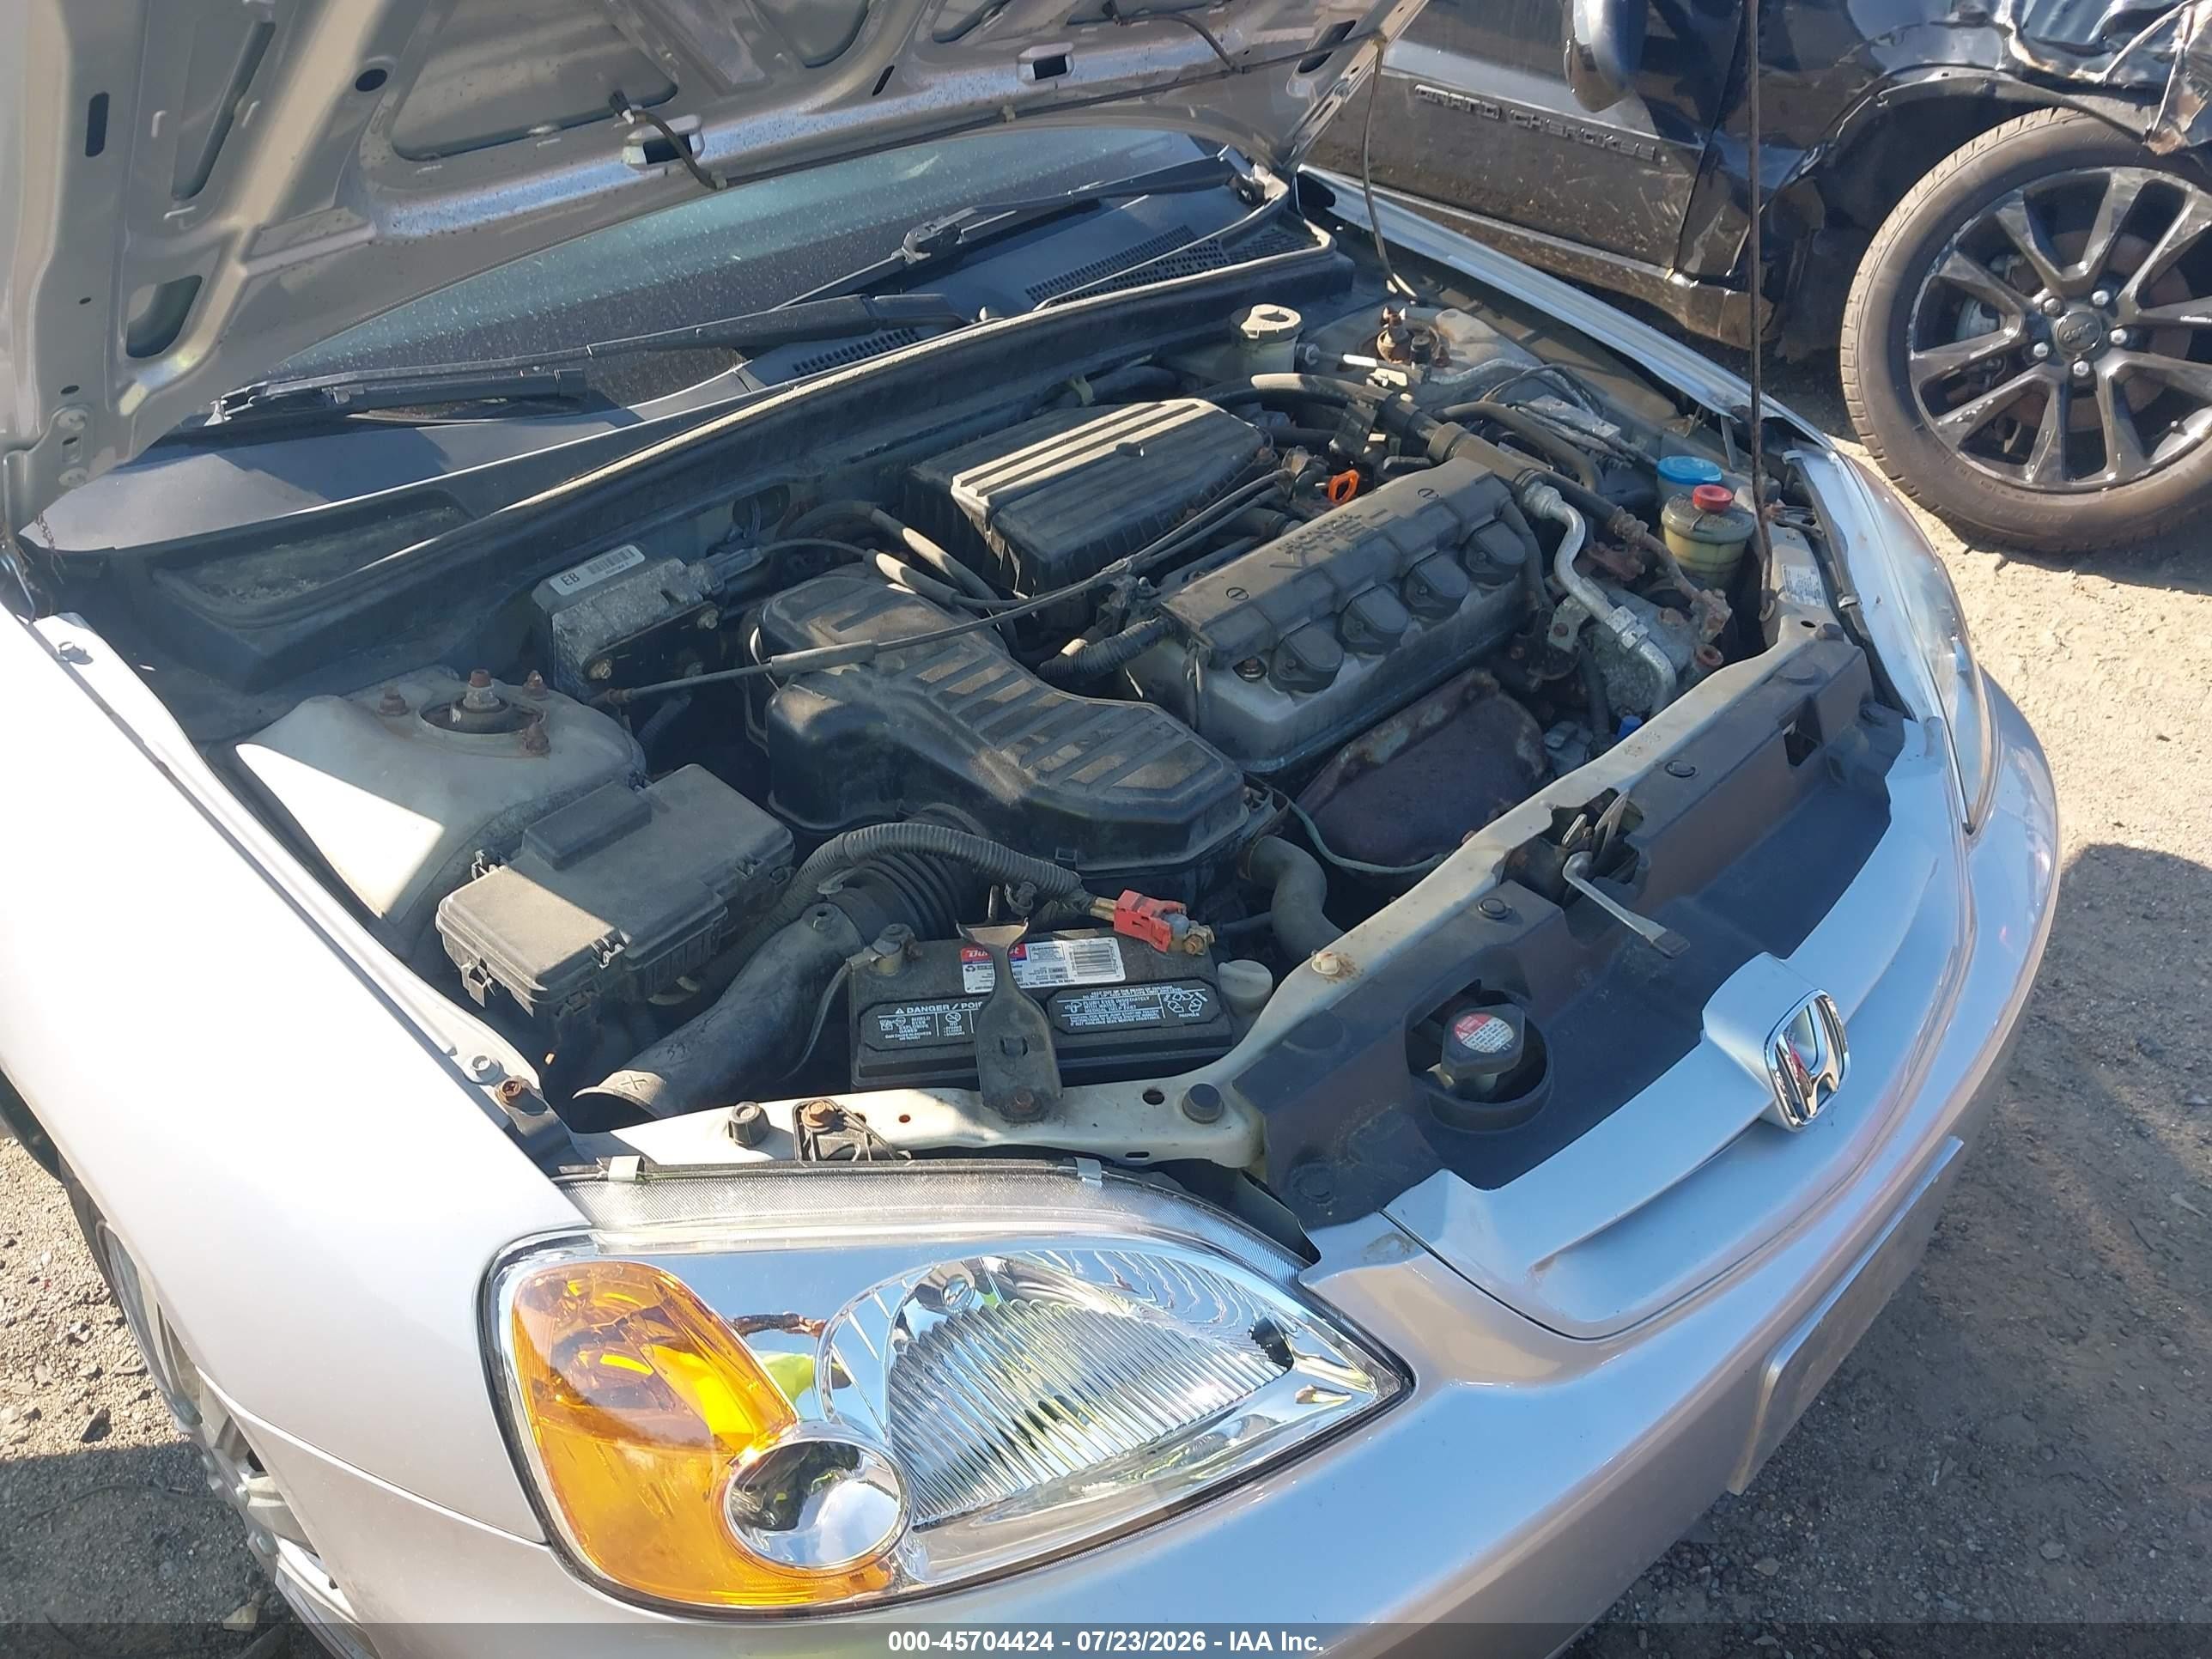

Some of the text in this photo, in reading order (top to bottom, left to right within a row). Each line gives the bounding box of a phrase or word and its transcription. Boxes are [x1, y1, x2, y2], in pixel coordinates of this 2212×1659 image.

[1510, 108, 1656, 161] CHEROKEE
[560, 572, 580, 586] EB
[906, 1004, 950, 1014] DANGER
